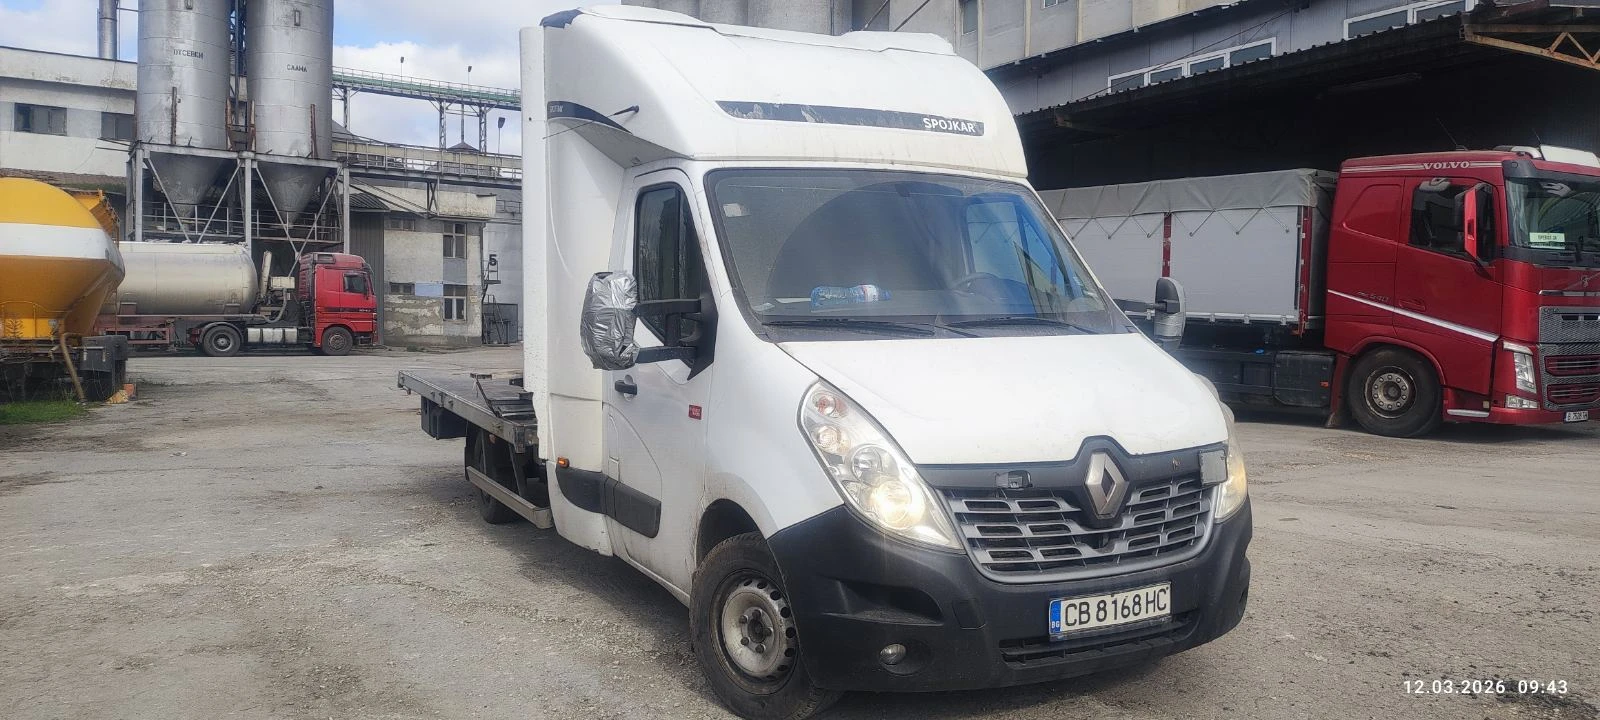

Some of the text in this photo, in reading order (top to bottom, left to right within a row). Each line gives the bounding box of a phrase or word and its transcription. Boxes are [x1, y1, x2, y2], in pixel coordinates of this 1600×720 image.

[922, 117, 976, 132] SPOJKAR
[1423, 161, 1470, 170] VOLVO
[1065, 588, 1168, 627] CB 8168 HC
[1051, 620, 1060, 629] BG
